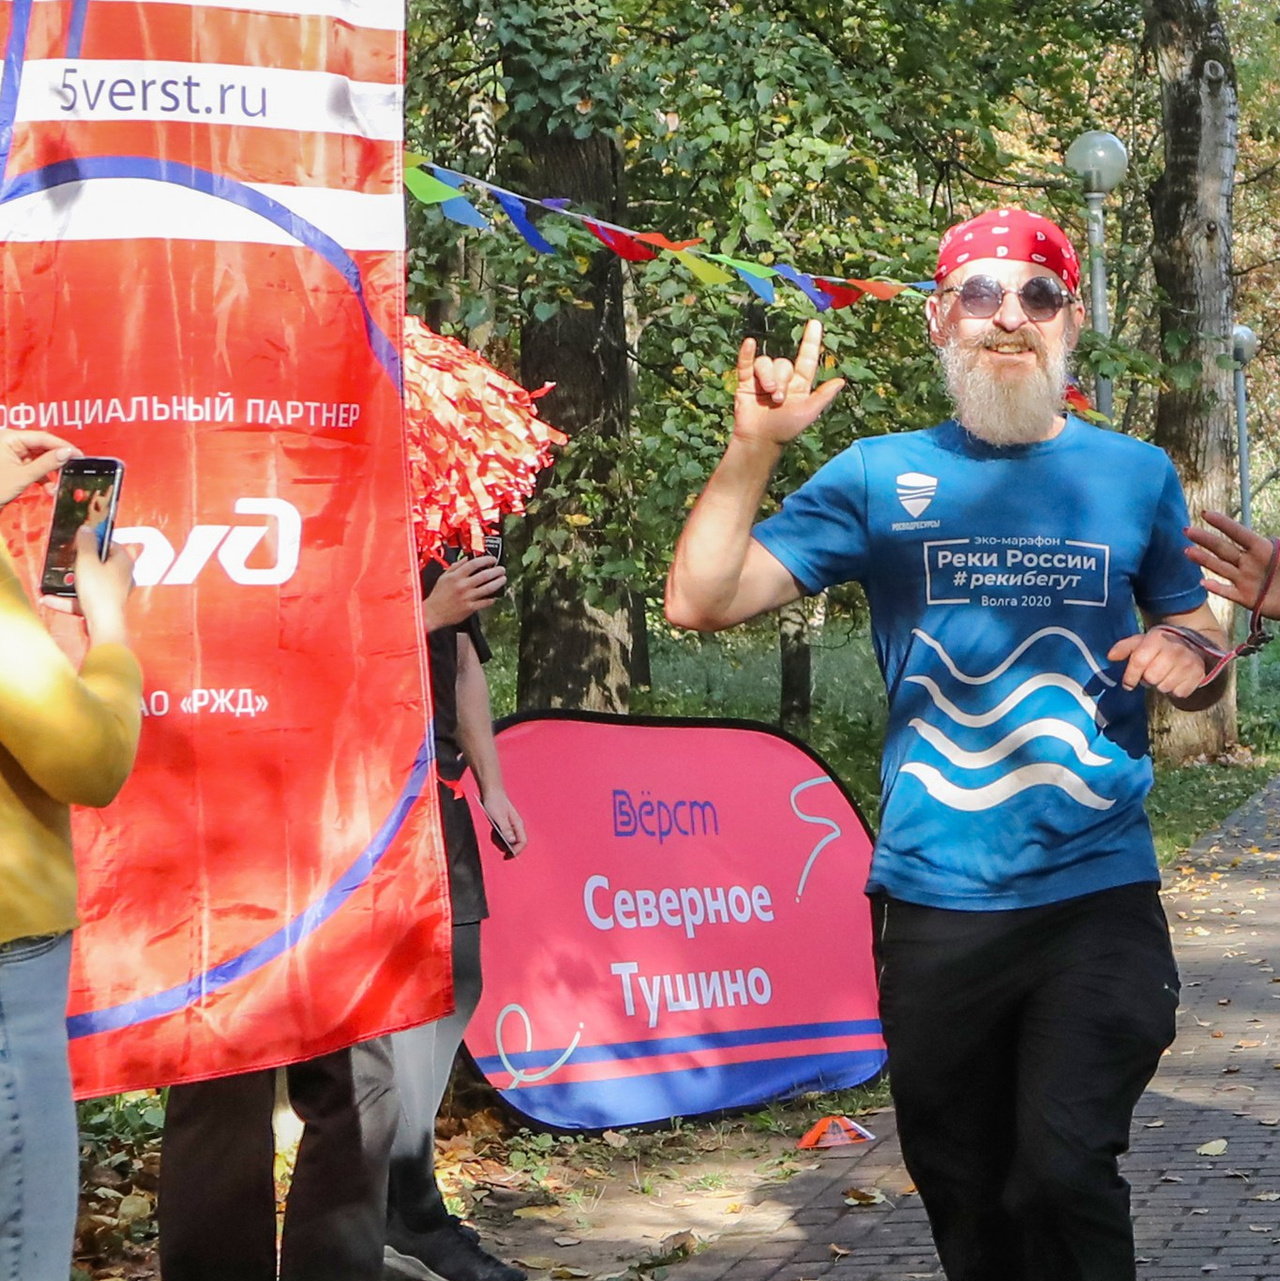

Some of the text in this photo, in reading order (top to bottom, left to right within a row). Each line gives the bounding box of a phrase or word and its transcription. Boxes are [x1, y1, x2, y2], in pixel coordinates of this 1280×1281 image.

[60, 68, 267, 118] 5verst.ru
[246, 398, 360, 428] ПАРТНЕР
[974, 535, 1061, 548] эко-марафон
[937, 549, 1097, 571] Реки России
[981, 595, 1052, 607] Волга 2020
[180, 688, 269, 718] «РЖД»
[583, 874, 775, 939] Северное
[610, 961, 773, 1029] Тушино
